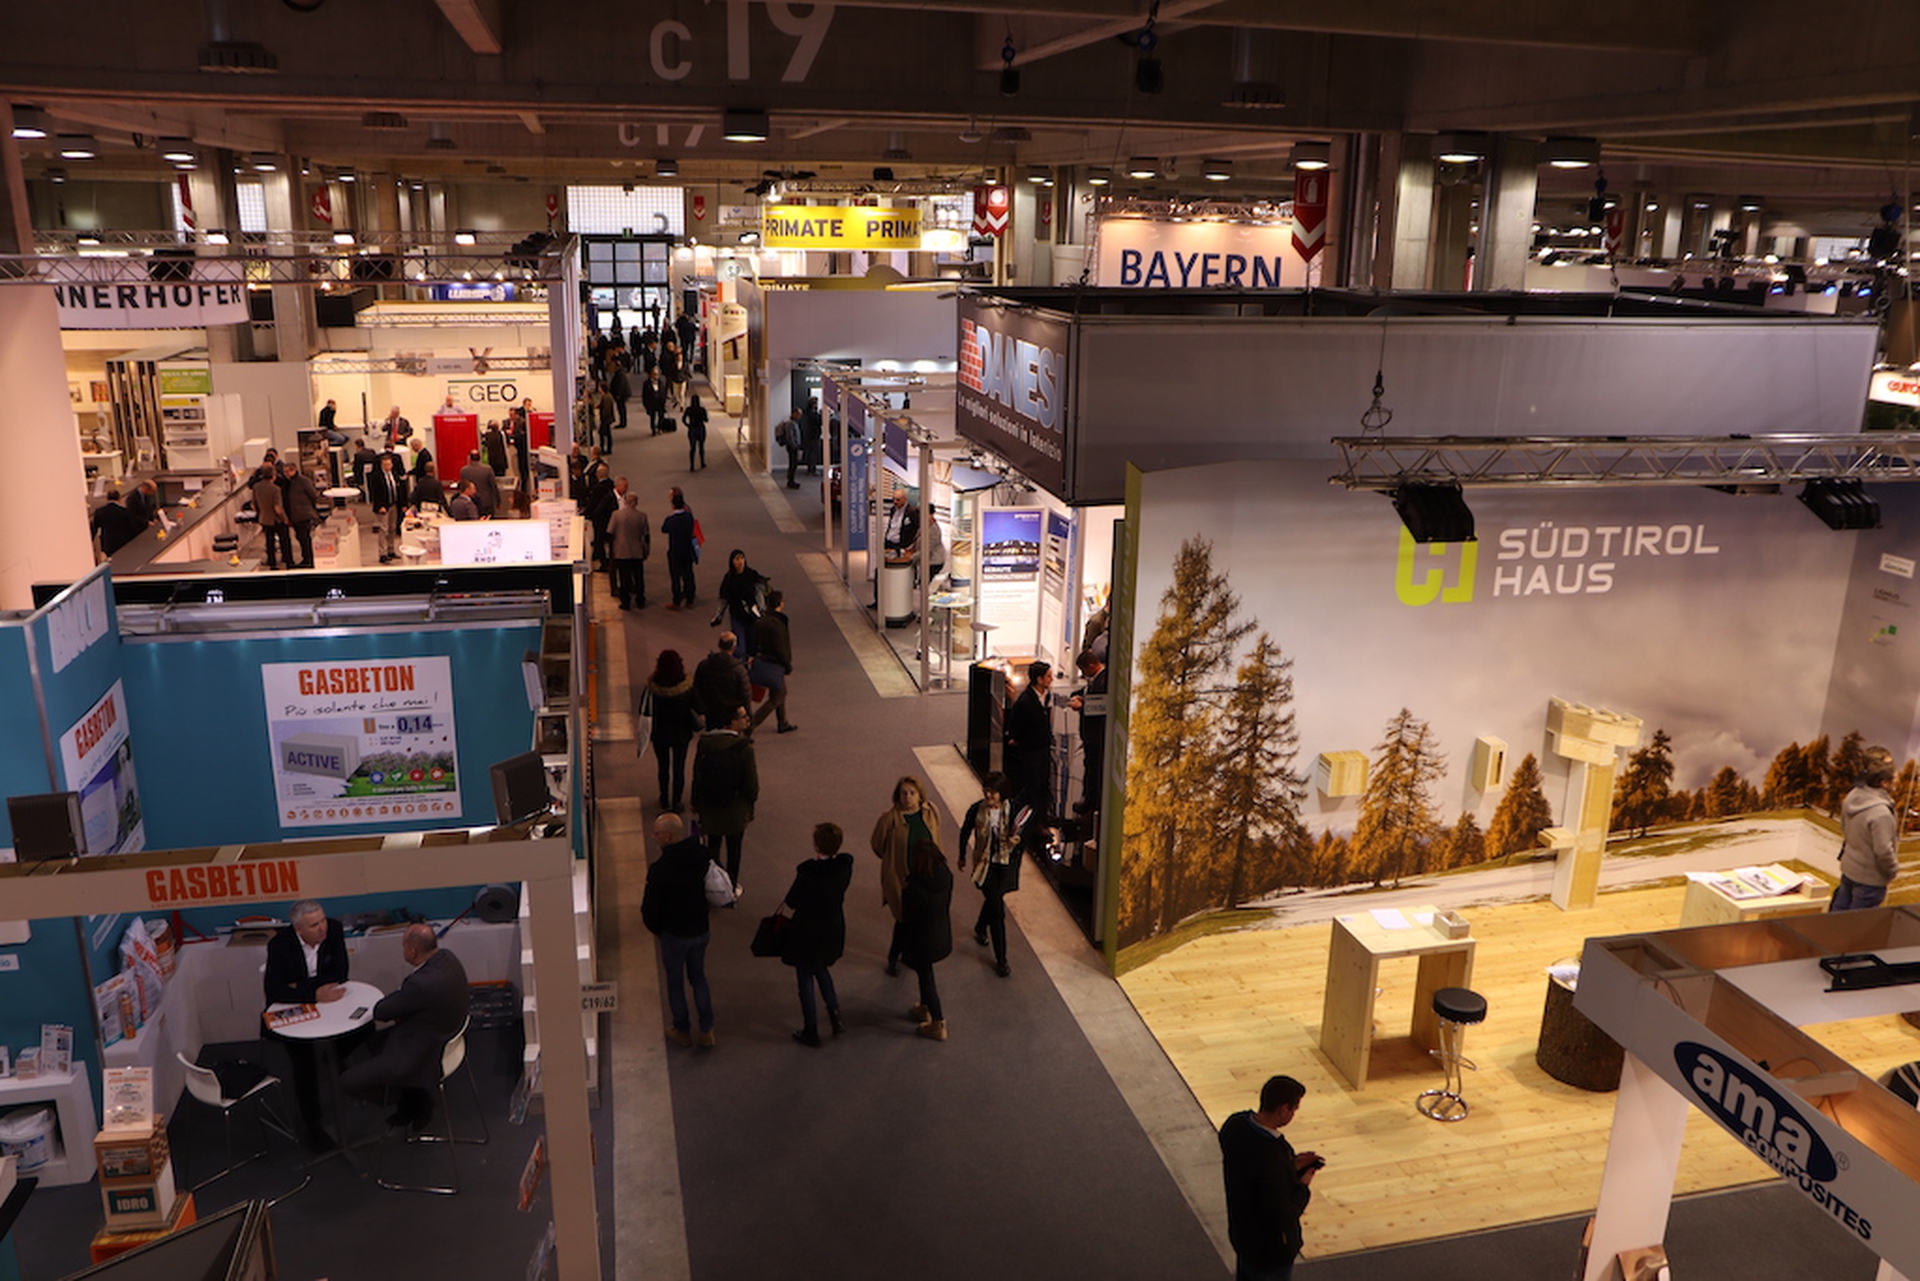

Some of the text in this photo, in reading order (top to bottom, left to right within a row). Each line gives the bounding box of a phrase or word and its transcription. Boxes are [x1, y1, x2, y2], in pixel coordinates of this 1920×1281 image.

[766, 219, 843, 237] PRIMATE
[1120, 249, 1282, 288] BAYERN
[468, 383, 518, 402] GEO
[976, 325, 1066, 434] DANESI
[1497, 522, 1720, 560] SÜDTIROL
[1493, 563, 1615, 597] HAUS
[298, 665, 415, 695] GASBETON
[284, 704, 308, 716] Più
[313, 700, 366, 715] isolante
[372, 697, 397, 711] che
[397, 714, 432, 733] 0,14
[74, 694, 118, 759] GASBETON
[287, 751, 341, 770] ACTIVE
[146, 861, 299, 903] GASBETON
[1692, 1052, 1813, 1171] ama
[1743, 1127, 1873, 1241] COMPOSITES
[117, 1196, 149, 1211] IDRO
